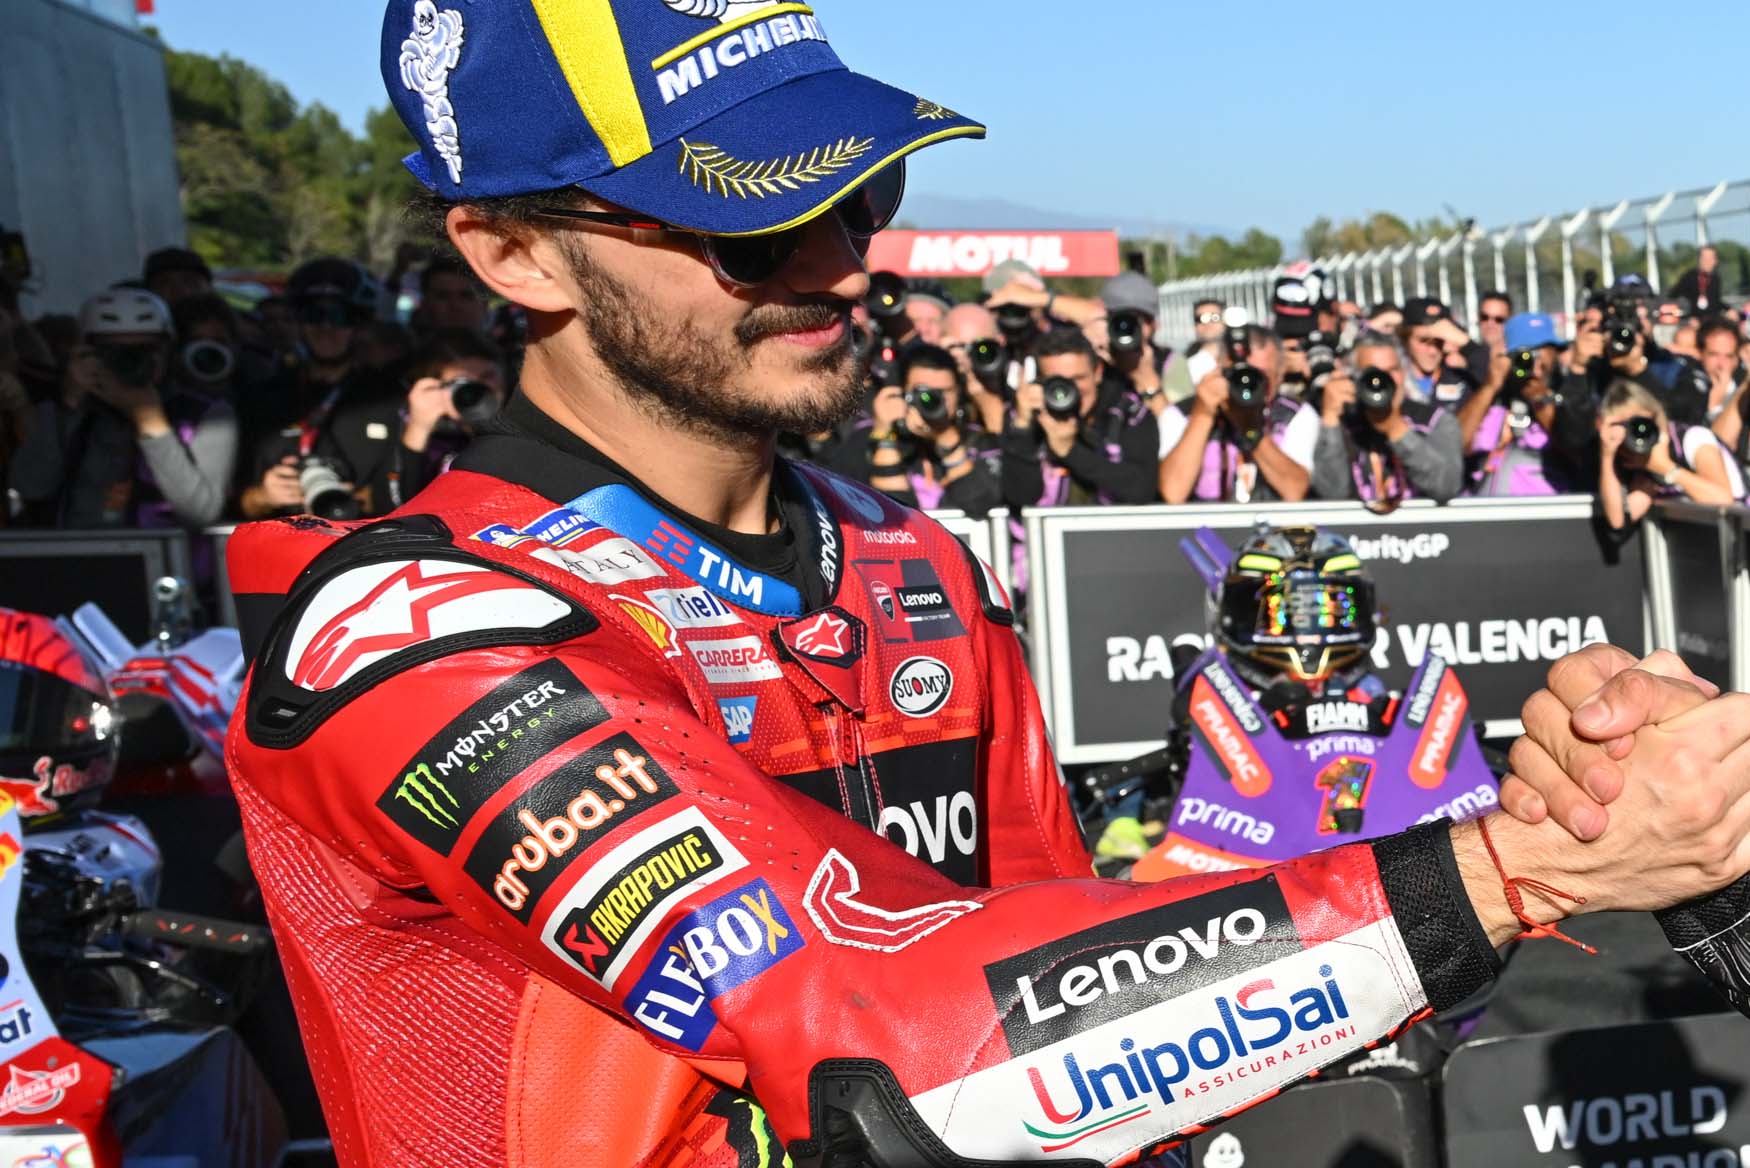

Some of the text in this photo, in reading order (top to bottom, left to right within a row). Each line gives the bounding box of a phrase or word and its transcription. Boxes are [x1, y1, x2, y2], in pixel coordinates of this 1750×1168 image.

[656, 14, 828, 105] MICHELIN
[908, 235, 1069, 272] MOTUL
[535, 514, 591, 542] HELIN
[863, 529, 917, 545] motorola
[1349, 533, 1449, 563] arityGP
[698, 546, 763, 605] TIM
[898, 592, 943, 607] Lenovo
[695, 647, 773, 667] CARRERA
[1397, 616, 1610, 667] VALENCIA
[894, 675, 948, 698] SUOMY
[435, 680, 566, 776] MONSTER
[468, 708, 555, 773] ENERGY
[720, 705, 751, 735] SAP
[1196, 700, 1260, 782] PRAMAC
[1306, 735, 1376, 763] prima
[1419, 691, 1463, 774] PRAMAC
[493, 748, 658, 911] aruba.it
[876, 790, 977, 864] ovo
[1177, 798, 1275, 845] prima
[590, 833, 712, 946] AKRAPOVIČ
[1016, 907, 1266, 1025] Lenovo
[0, 1007, 31, 1044] at
[1027, 964, 1350, 1125] UnipolSai
[1183, 1024, 1357, 1099] ASSICURAZIONI
[1522, 1086, 1727, 1153] WORLD
